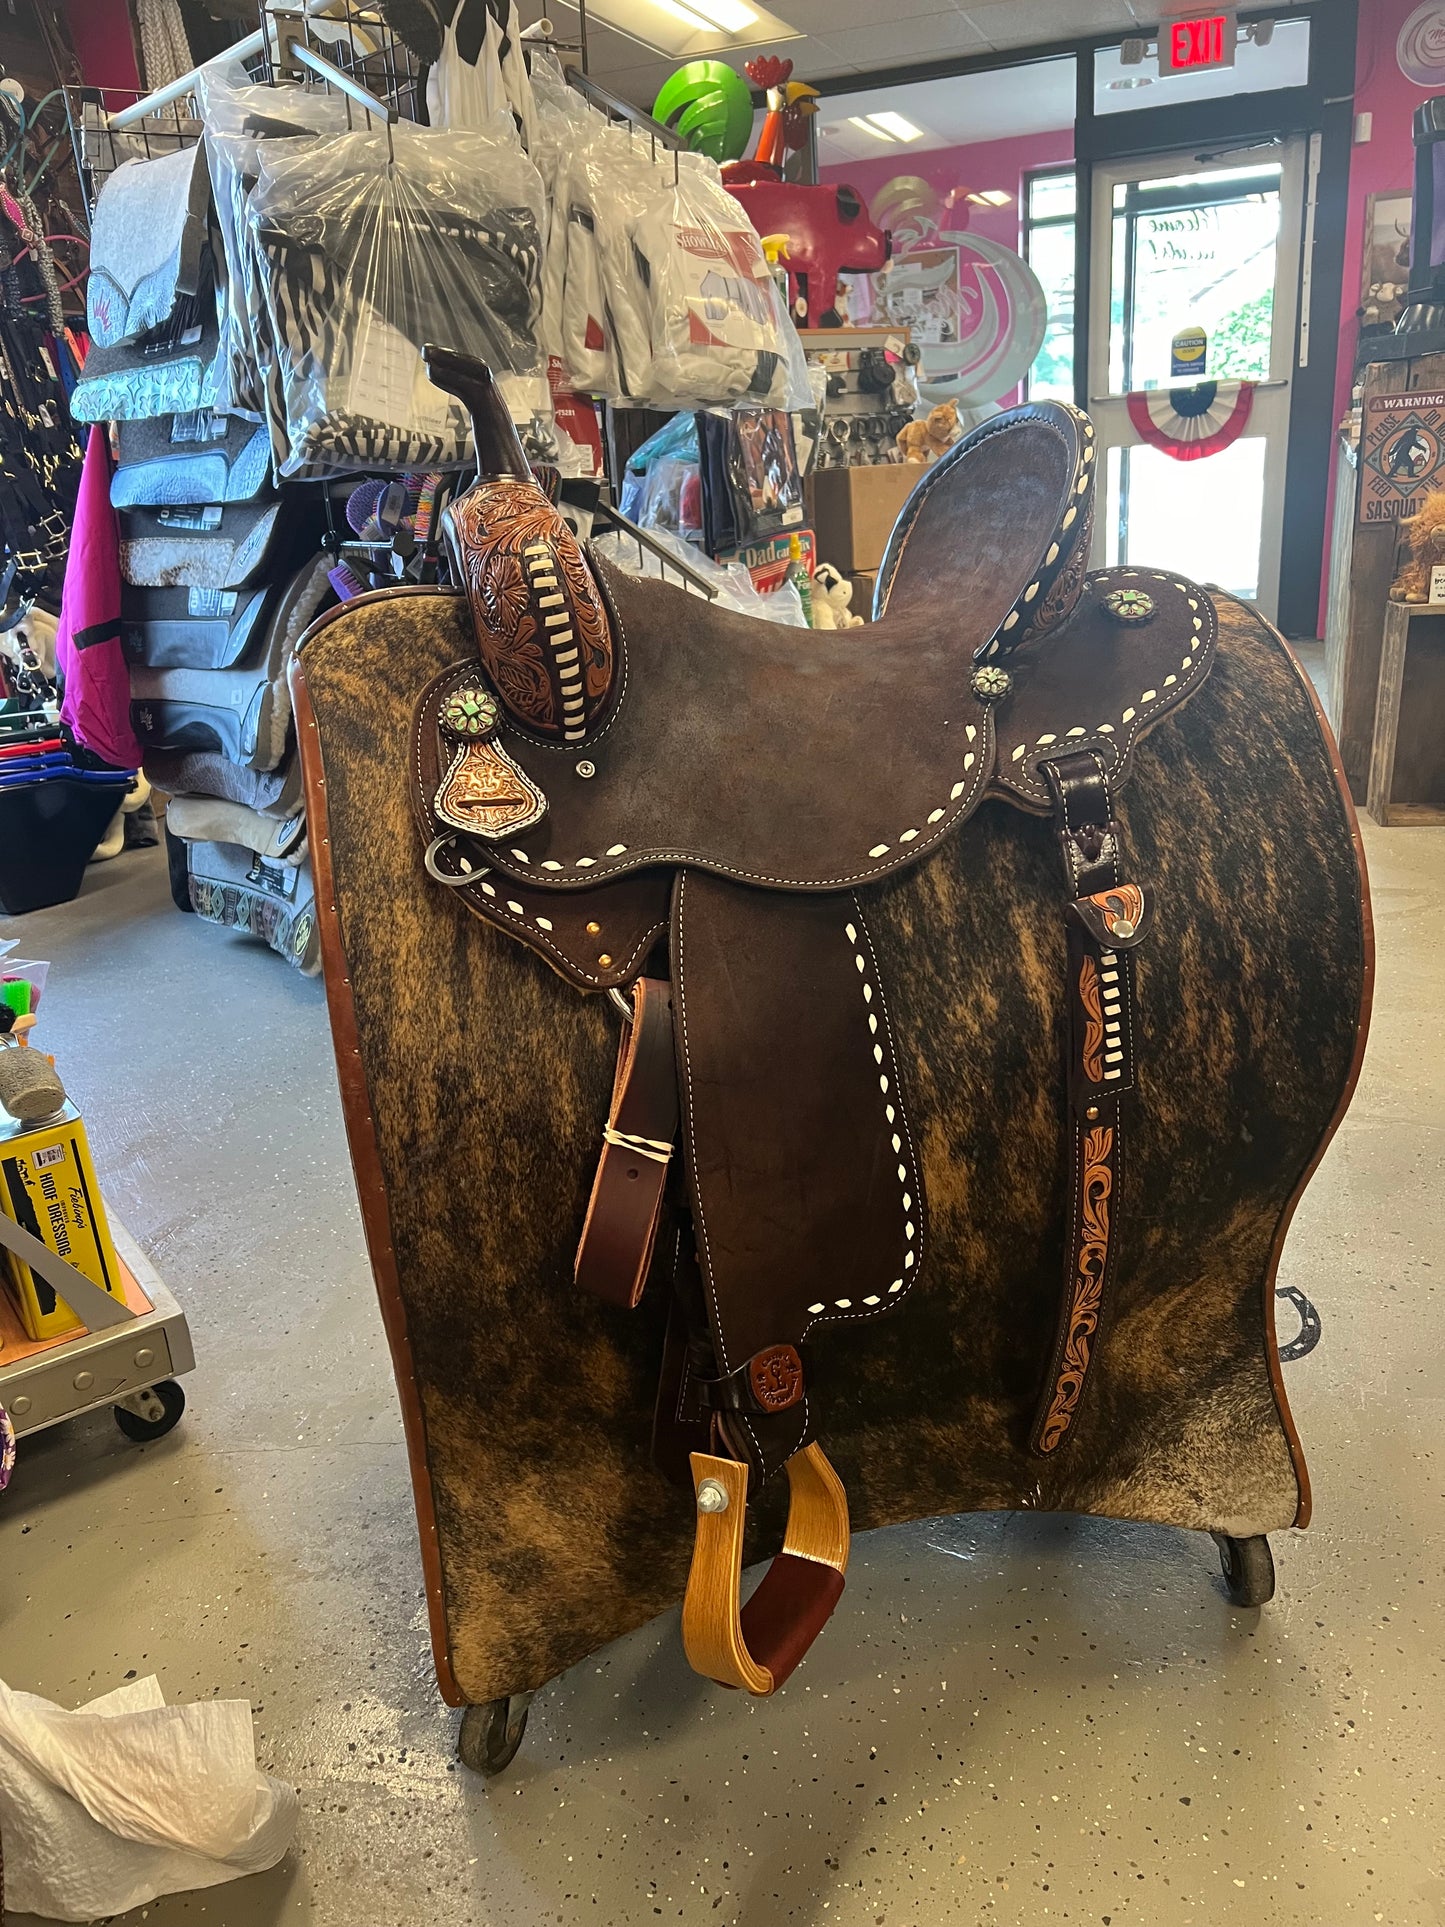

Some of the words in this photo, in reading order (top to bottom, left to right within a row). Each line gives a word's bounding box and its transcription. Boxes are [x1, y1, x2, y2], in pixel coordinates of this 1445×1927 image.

[1171, 16, 1226, 68] EXIT
[1175, 339, 1204, 347] CAUTION
[1384, 396, 1444, 409] WARNING
[1367, 413, 1400, 446] PLEASE
[1423, 409, 1441, 426] DO
[1367, 475, 1392, 498] FEED
[745, 541, 776, 568] Dad
[39, 1172, 58, 1201] HOOF
[68, 1187, 86, 1229] Fiebing's
[47, 1202, 72, 1257] DRESSING
